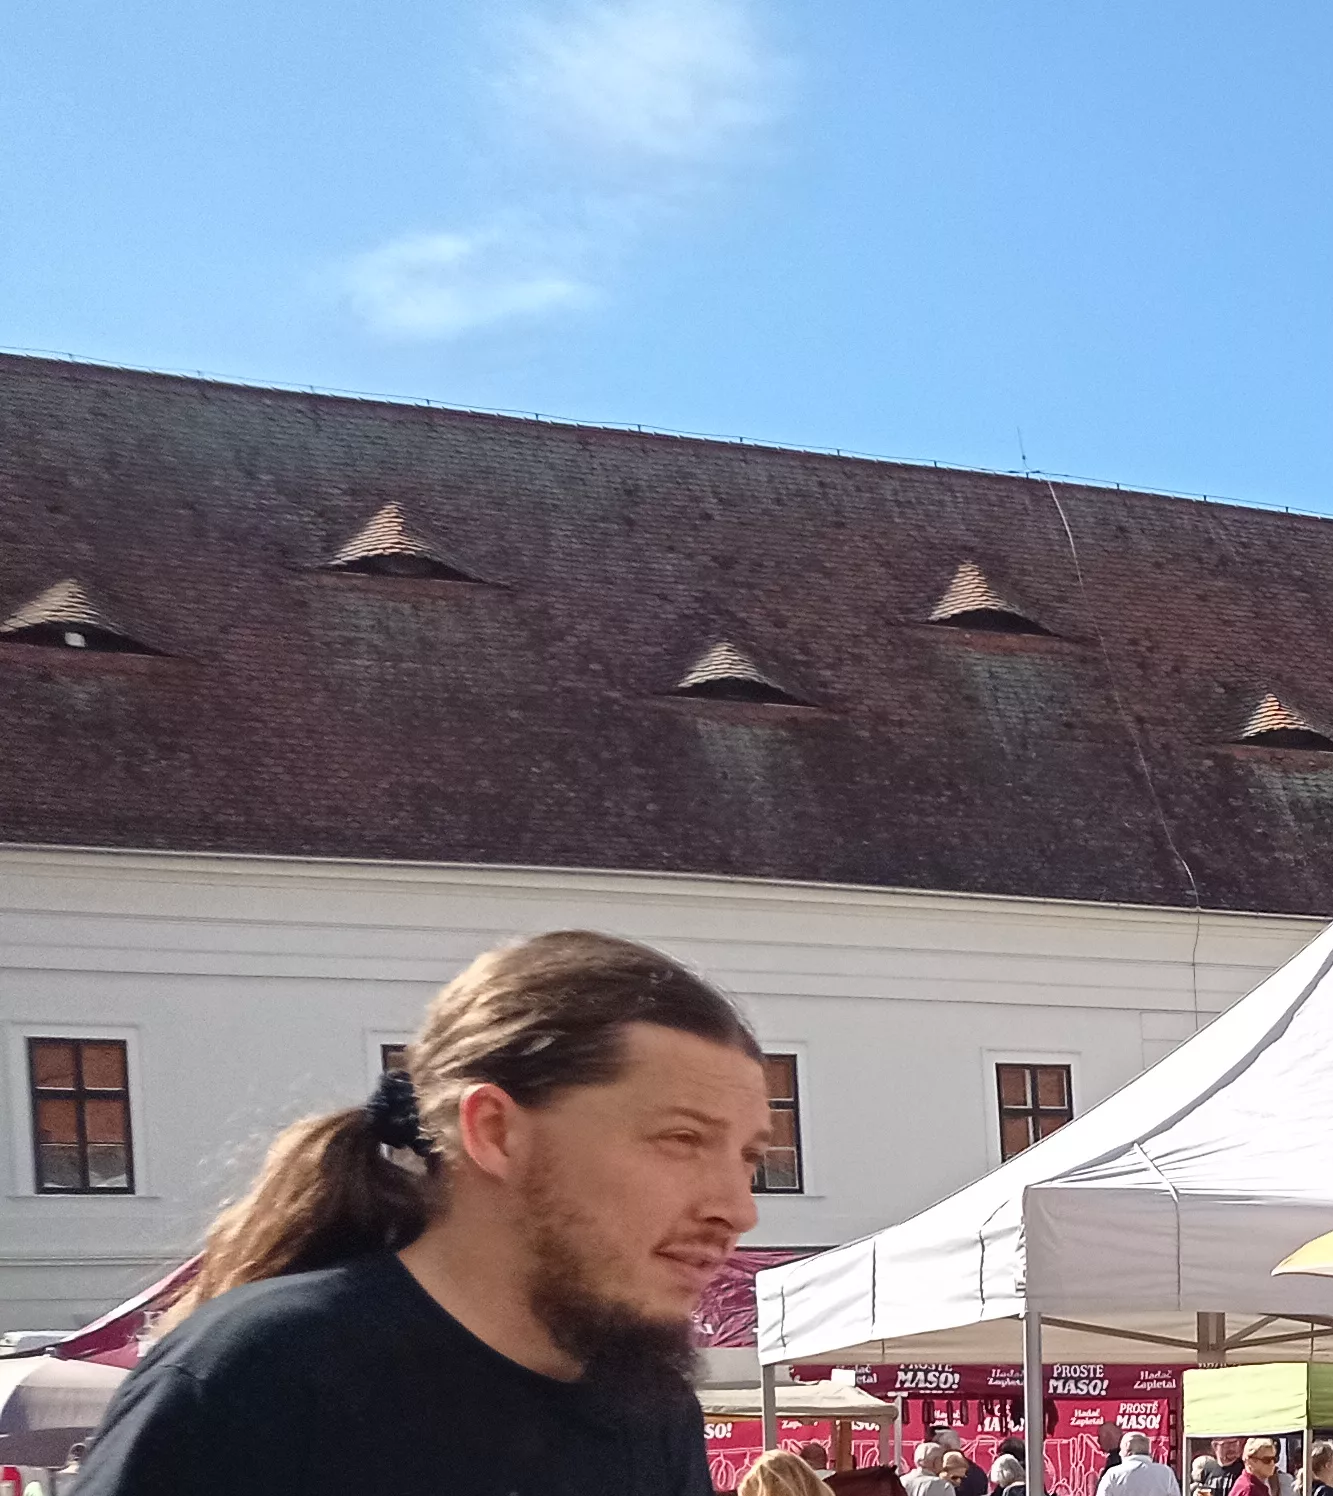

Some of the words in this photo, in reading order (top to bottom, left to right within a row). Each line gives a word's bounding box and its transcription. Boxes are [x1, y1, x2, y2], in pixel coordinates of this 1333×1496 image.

[895, 1371, 960, 1389] MASO!
[1048, 1379, 1109, 1396] MASO!
[1134, 1379, 1177, 1391] Zapletal
[703, 1422, 733, 1439] SO!
[1116, 1414, 1161, 1430] MASO!
